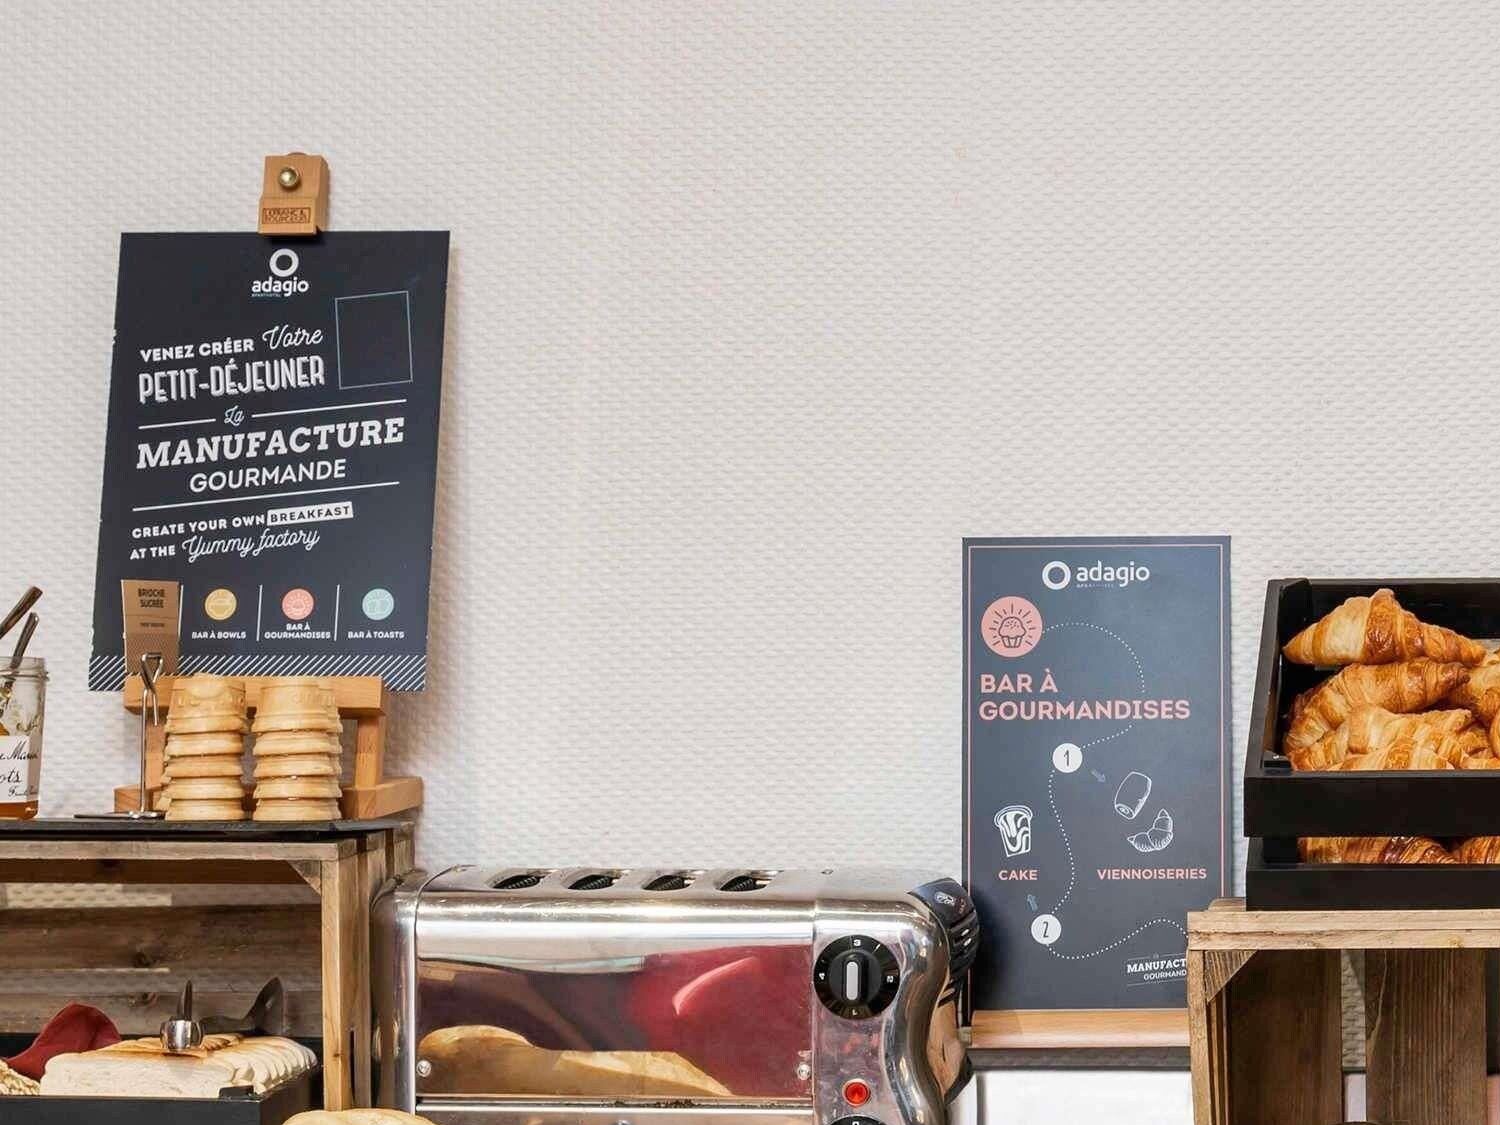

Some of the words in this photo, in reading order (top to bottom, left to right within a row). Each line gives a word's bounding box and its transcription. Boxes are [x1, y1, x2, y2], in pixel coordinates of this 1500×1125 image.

[252, 276, 310, 297] adagio
[140, 344, 194, 362] VENEZ
[199, 337, 254, 356] CRÉER
[262, 324, 323, 350] Votre
[138, 355, 325, 405] PETIT-DÉJEUNER
[223, 405, 244, 426] La
[136, 417, 406, 469] MANUFACTURE
[190, 458, 346, 493] GOURMANDE
[131, 523, 185, 539] CREATE
[189, 518, 227, 533] YOUR
[232, 514, 265, 529] OWN
[270, 505, 351, 523] BREAKFAST
[130, 548, 147, 560] AT
[150, 545, 176, 558] THE
[181, 535, 255, 563] Yummy
[252, 527, 320, 557] factory
[1076, 560, 1150, 588] adagio
[191, 631, 209, 640] BAR
[209, 629, 216, 639] À
[217, 631, 246, 640] BOWLS
[264, 631, 331, 640] GOURMANDISES
[286, 623, 303, 631] BAR
[303, 621, 311, 631] À
[347, 631, 365, 640] BAR
[365, 629, 373, 639] À
[373, 631, 405, 640] TOASTS
[980, 674, 1033, 693] BAR
[1040, 668, 1058, 693] À
[979, 700, 1191, 721] GOURMANDISES
[1063, 749, 1071, 767] 1
[998, 869, 1038, 881] CAKE
[1097, 868, 1207, 880] VIENNOISERIES
[1042, 921, 1050, 938] 2
[1127, 958, 1187, 973] MANUFACT
[1143, 969, 1187, 980] GOURMAND
